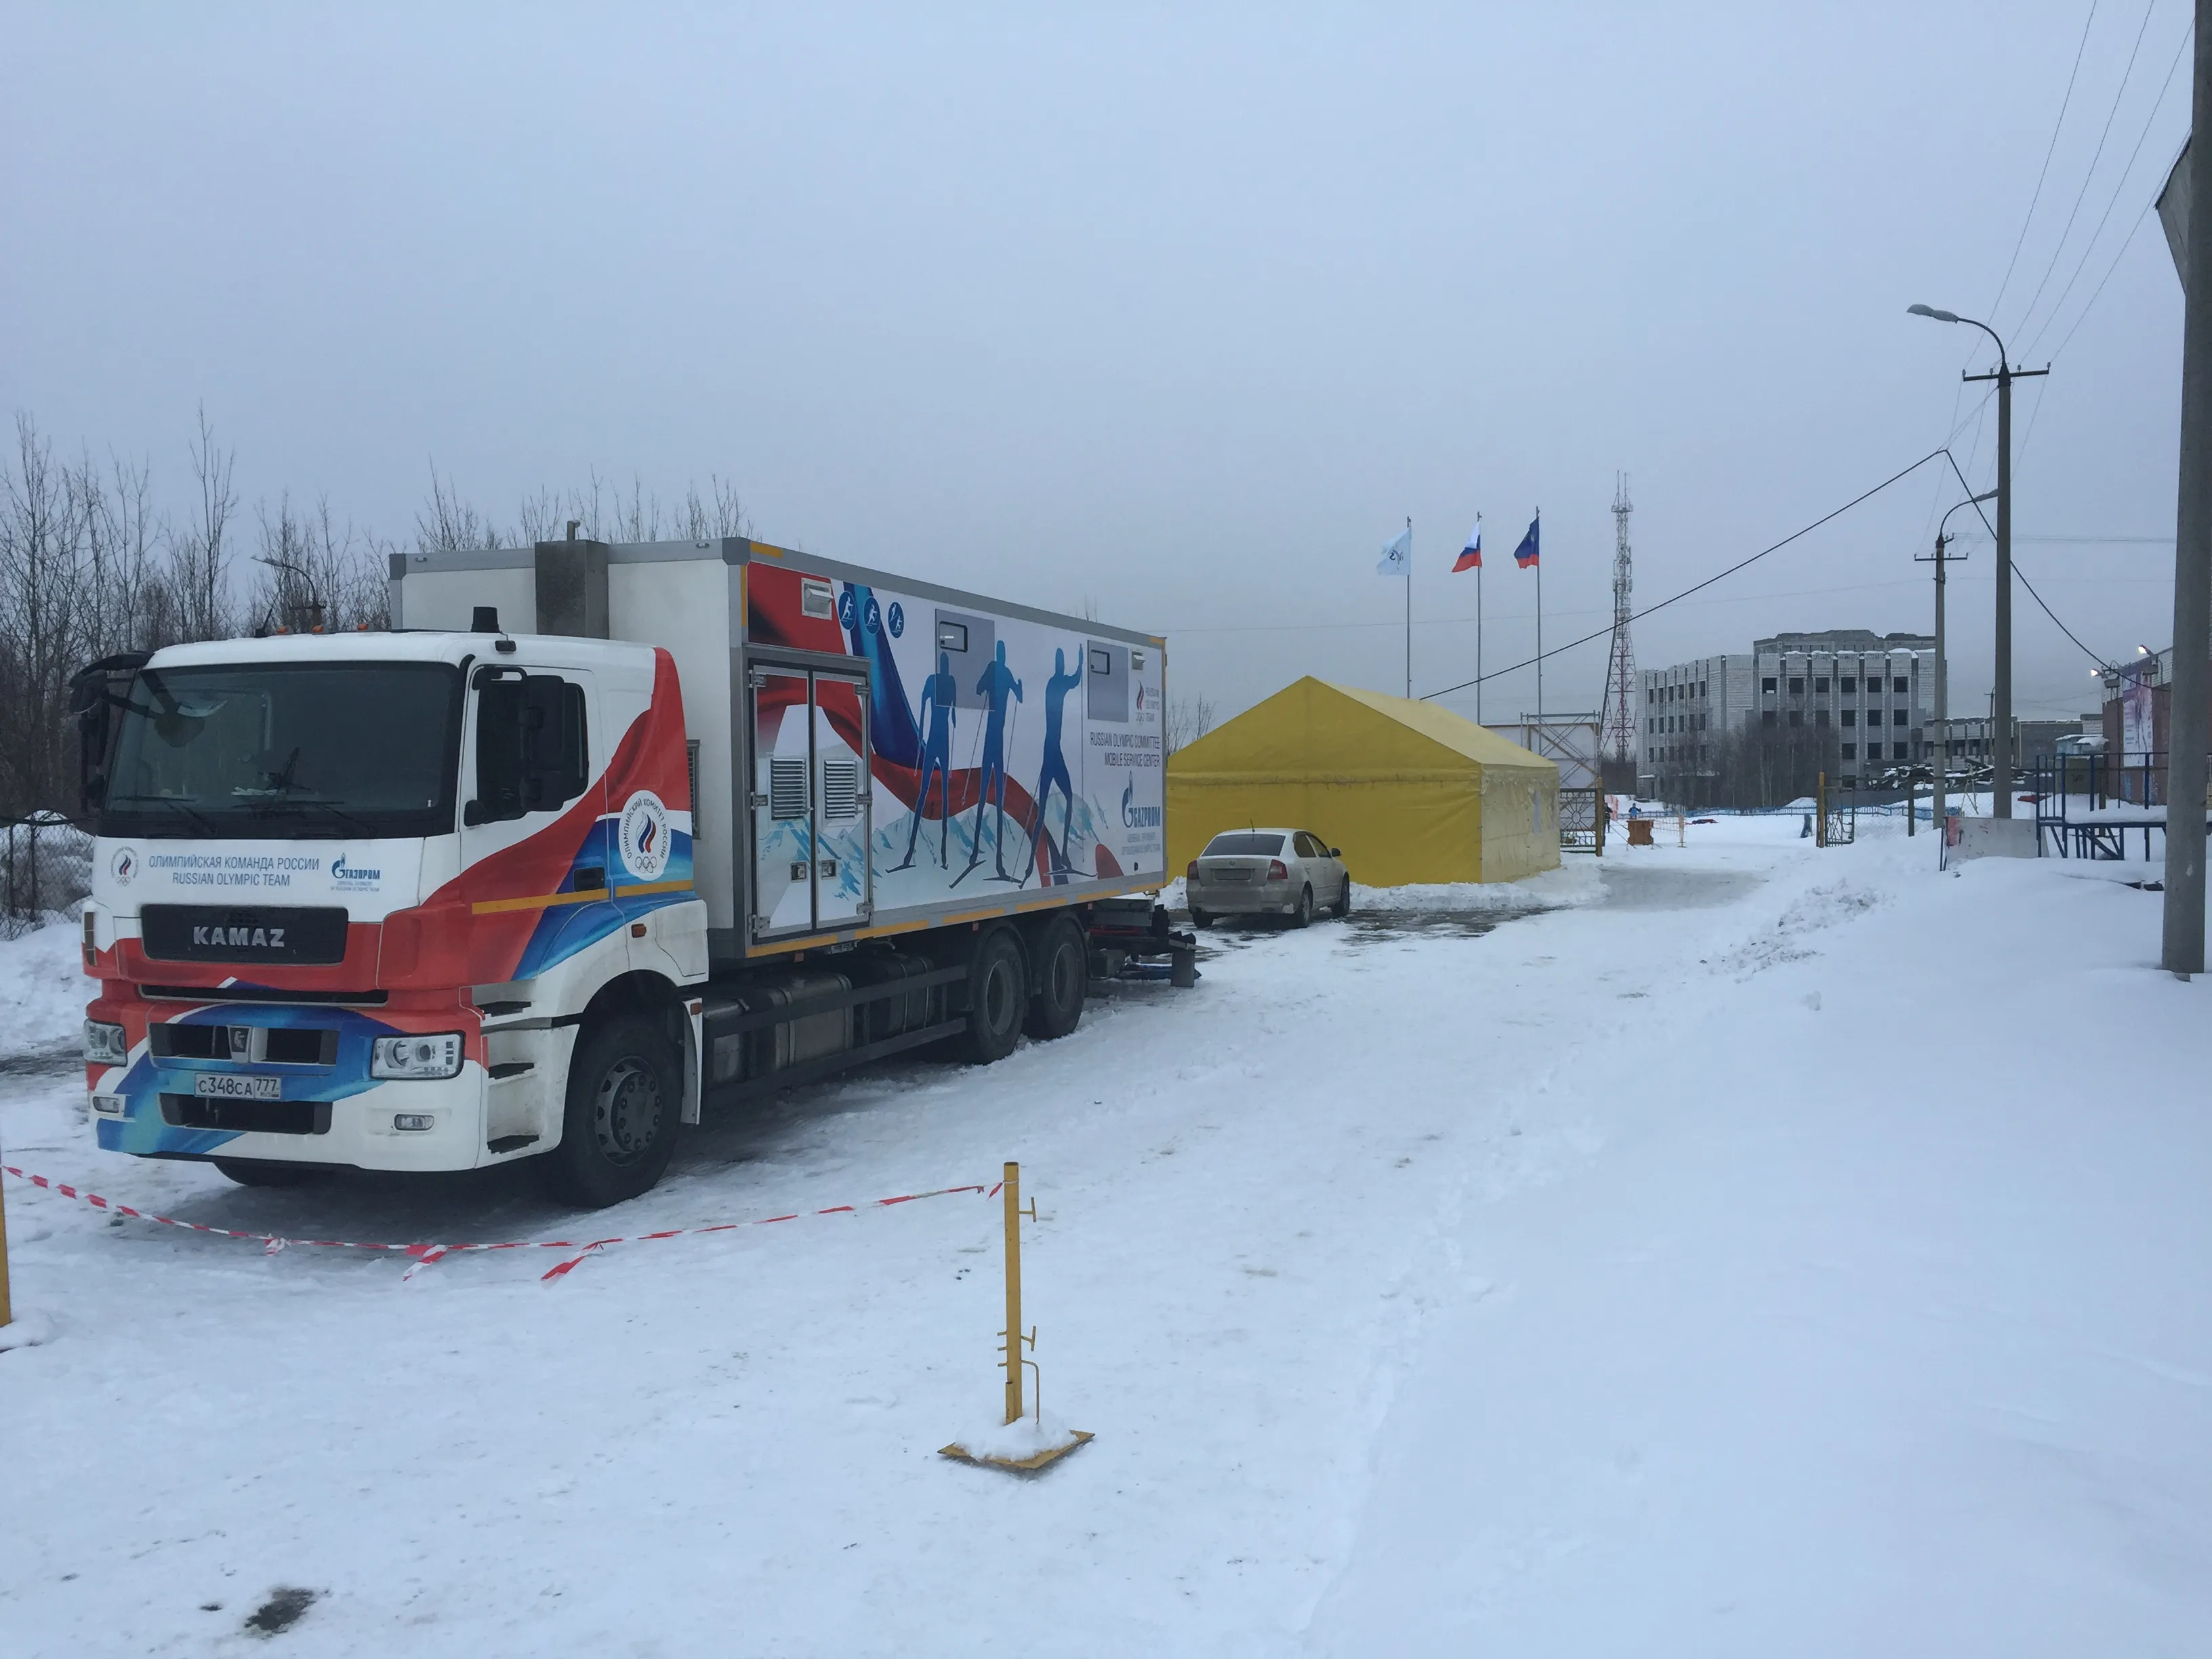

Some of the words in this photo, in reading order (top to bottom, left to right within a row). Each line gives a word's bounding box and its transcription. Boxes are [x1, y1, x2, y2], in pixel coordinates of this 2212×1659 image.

[1090, 732, 1112, 746] RUSSIAN
[1113, 733, 1134, 748] OLYMPIC
[1105, 752, 1123, 766] MOBILE
[1124, 753, 1143, 766] SERVICE
[1143, 754, 1160, 767] CENTER
[623, 798, 643, 859] ОЛИМПИЙСКИЙ
[643, 798, 665, 822] КОМИТЕТ
[659, 823, 668, 859] РОССИИ
[149, 854, 222, 868] ОЛИМПИЙСКАЯ
[224, 857, 274, 872] КОМАНДА
[277, 857, 319, 870] РОССИИ
[172, 872, 213, 884] RUSSIAN
[216, 872, 260, 886] OLYMPIC
[262, 874, 290, 886] TEAM
[345, 869, 380, 880] ГАЗПРОМ
[193, 926, 285, 947] KAMAZ
[255, 1078, 277, 1092] 777
